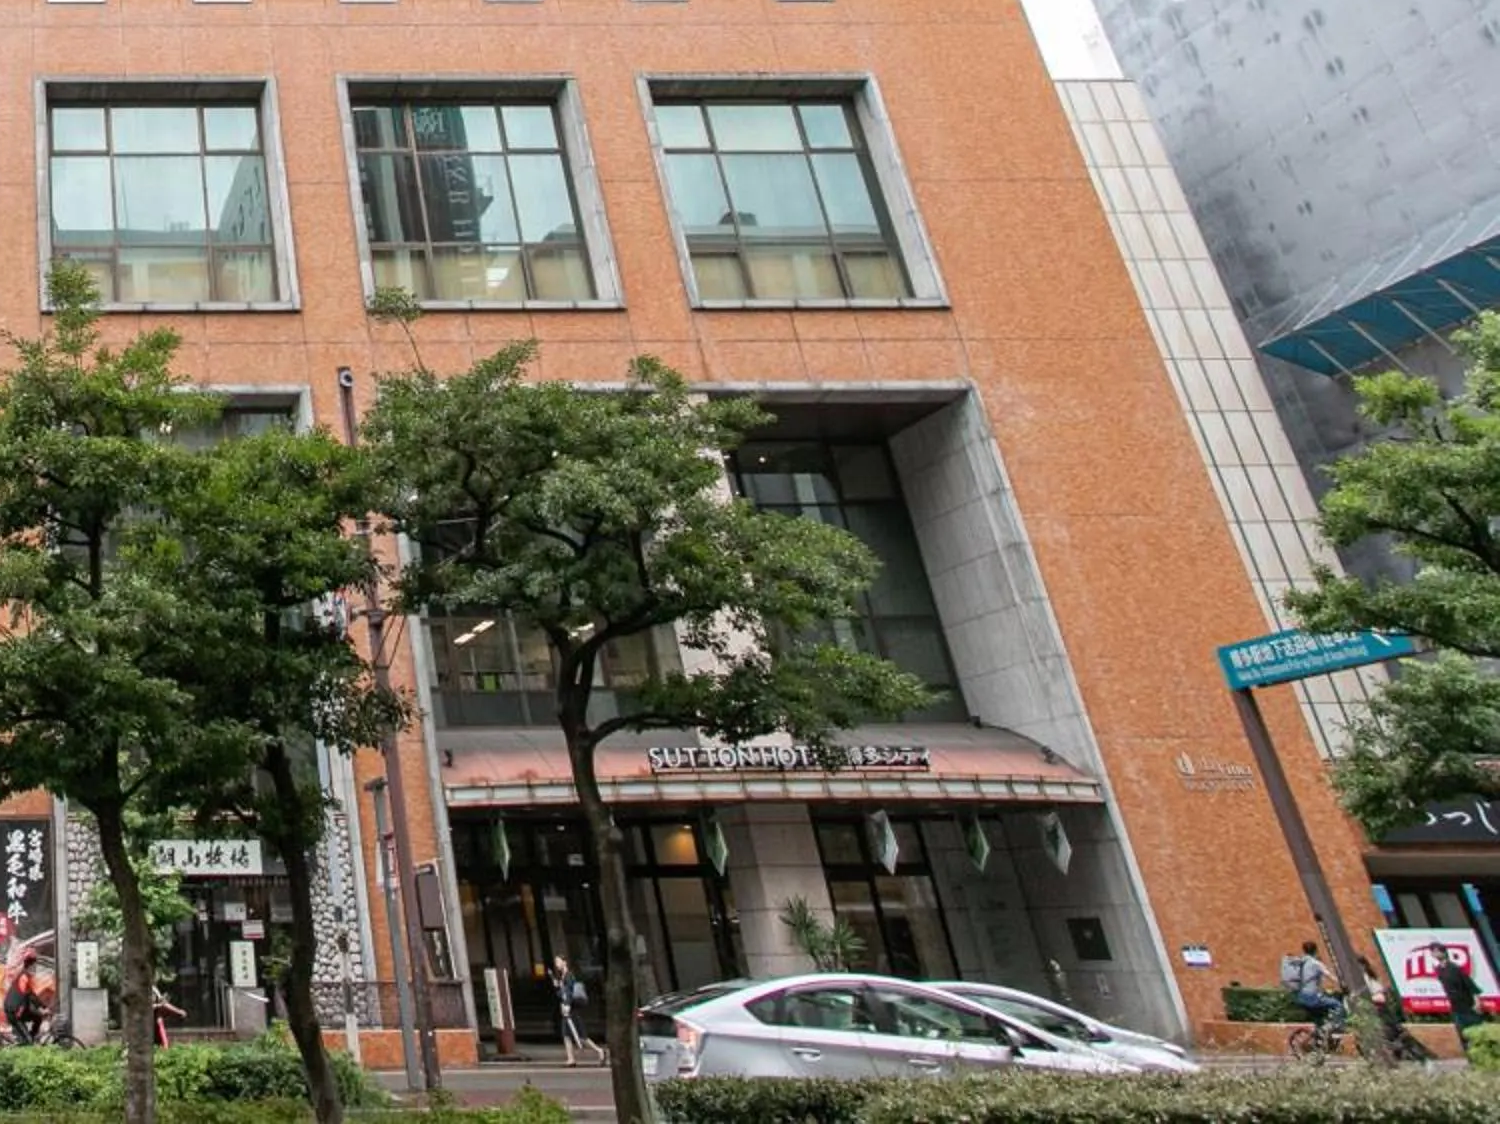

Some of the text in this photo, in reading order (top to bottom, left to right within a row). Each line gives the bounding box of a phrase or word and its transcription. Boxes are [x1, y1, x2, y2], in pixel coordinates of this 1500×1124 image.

[649, 745, 835, 769] SUTTON HOT
[5, 829, 29, 925] 黒毛和牛
